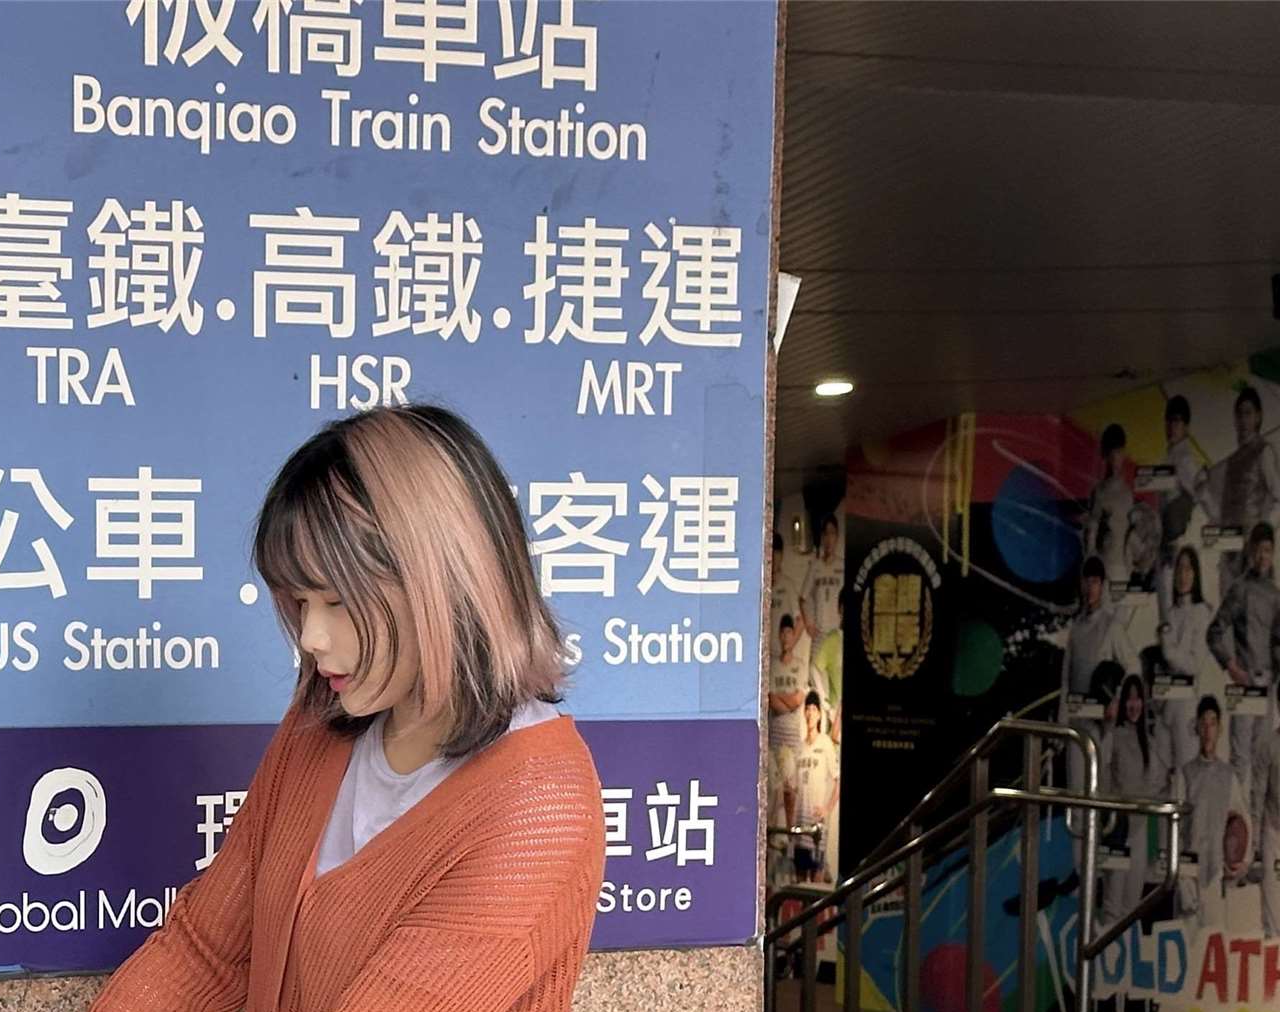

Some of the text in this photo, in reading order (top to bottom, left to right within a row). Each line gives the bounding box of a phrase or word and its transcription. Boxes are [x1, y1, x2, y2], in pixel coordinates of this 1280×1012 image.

[72, 75, 648, 161] Banqiao Train Station
[26, 347, 683, 416] TRA HSR MRT
[63, 621, 220, 671] Station
[603, 617, 744, 665] Station
[596, 881, 692, 913] Store
